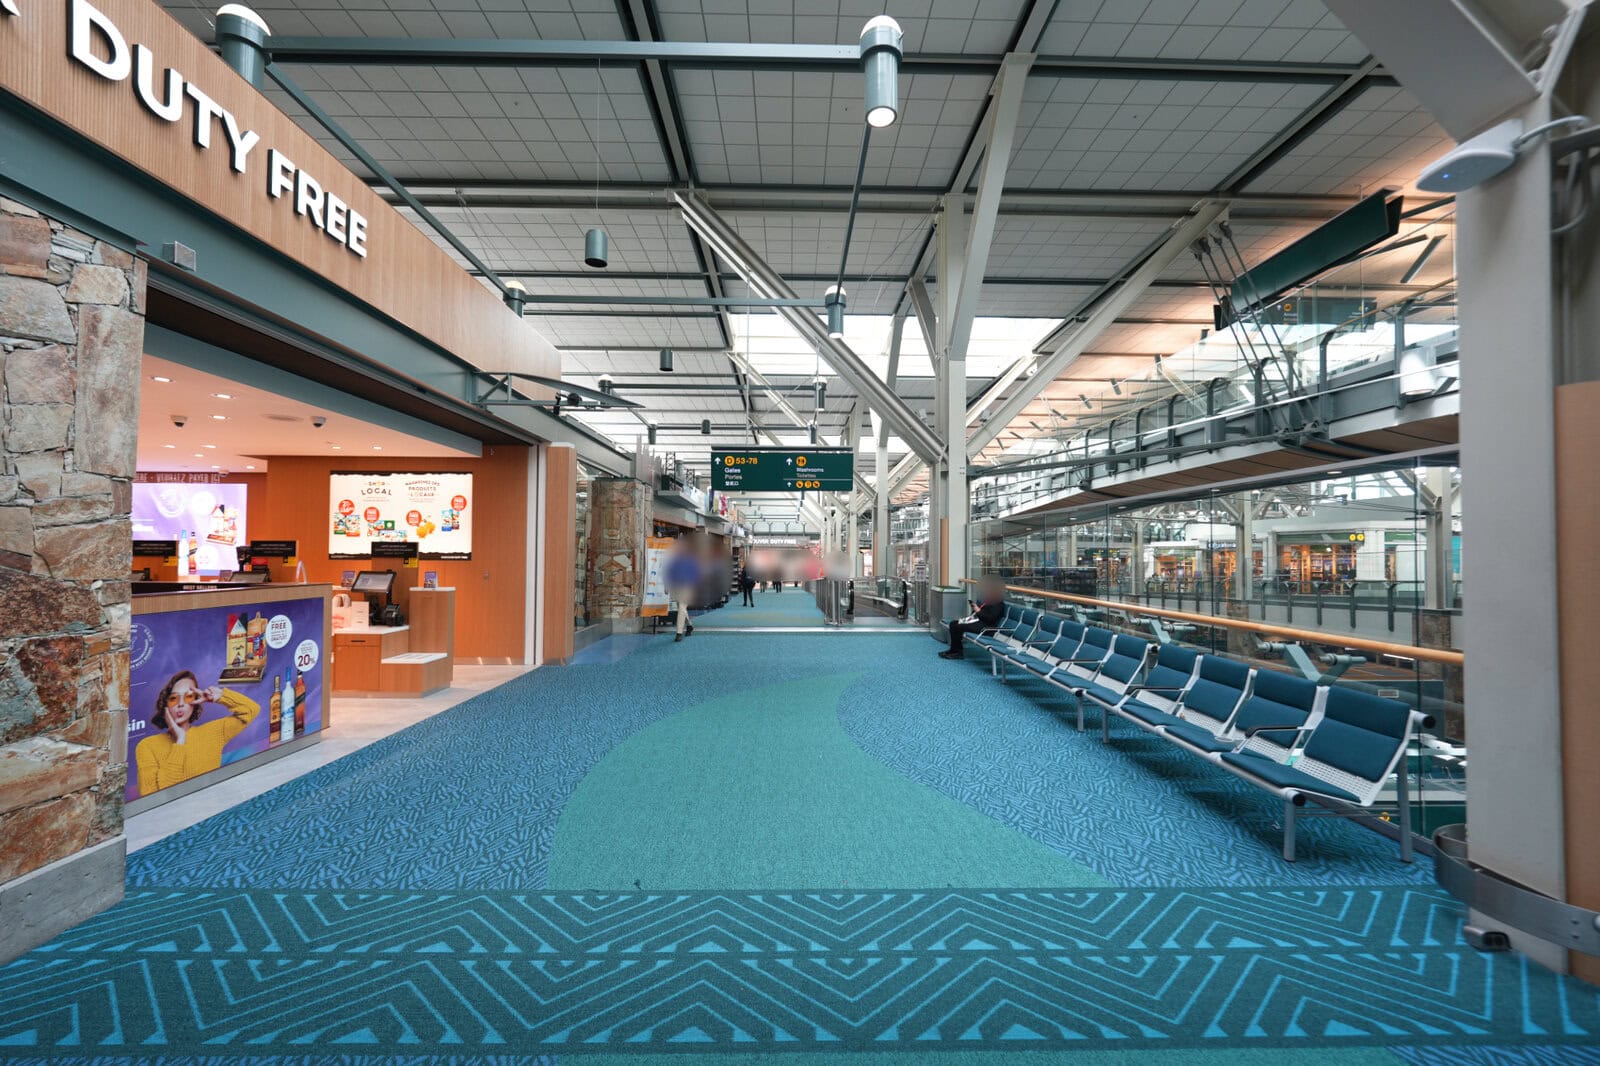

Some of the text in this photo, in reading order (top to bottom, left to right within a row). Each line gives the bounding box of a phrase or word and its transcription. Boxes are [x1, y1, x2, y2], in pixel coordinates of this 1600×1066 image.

[69, 0, 368, 258] DUTY FREE
[735, 457, 758, 465] 53-78
[188, 473, 208, 483] PAYER
[361, 487, 392, 496] LOCAL
[271, 622, 287, 631] FREE
